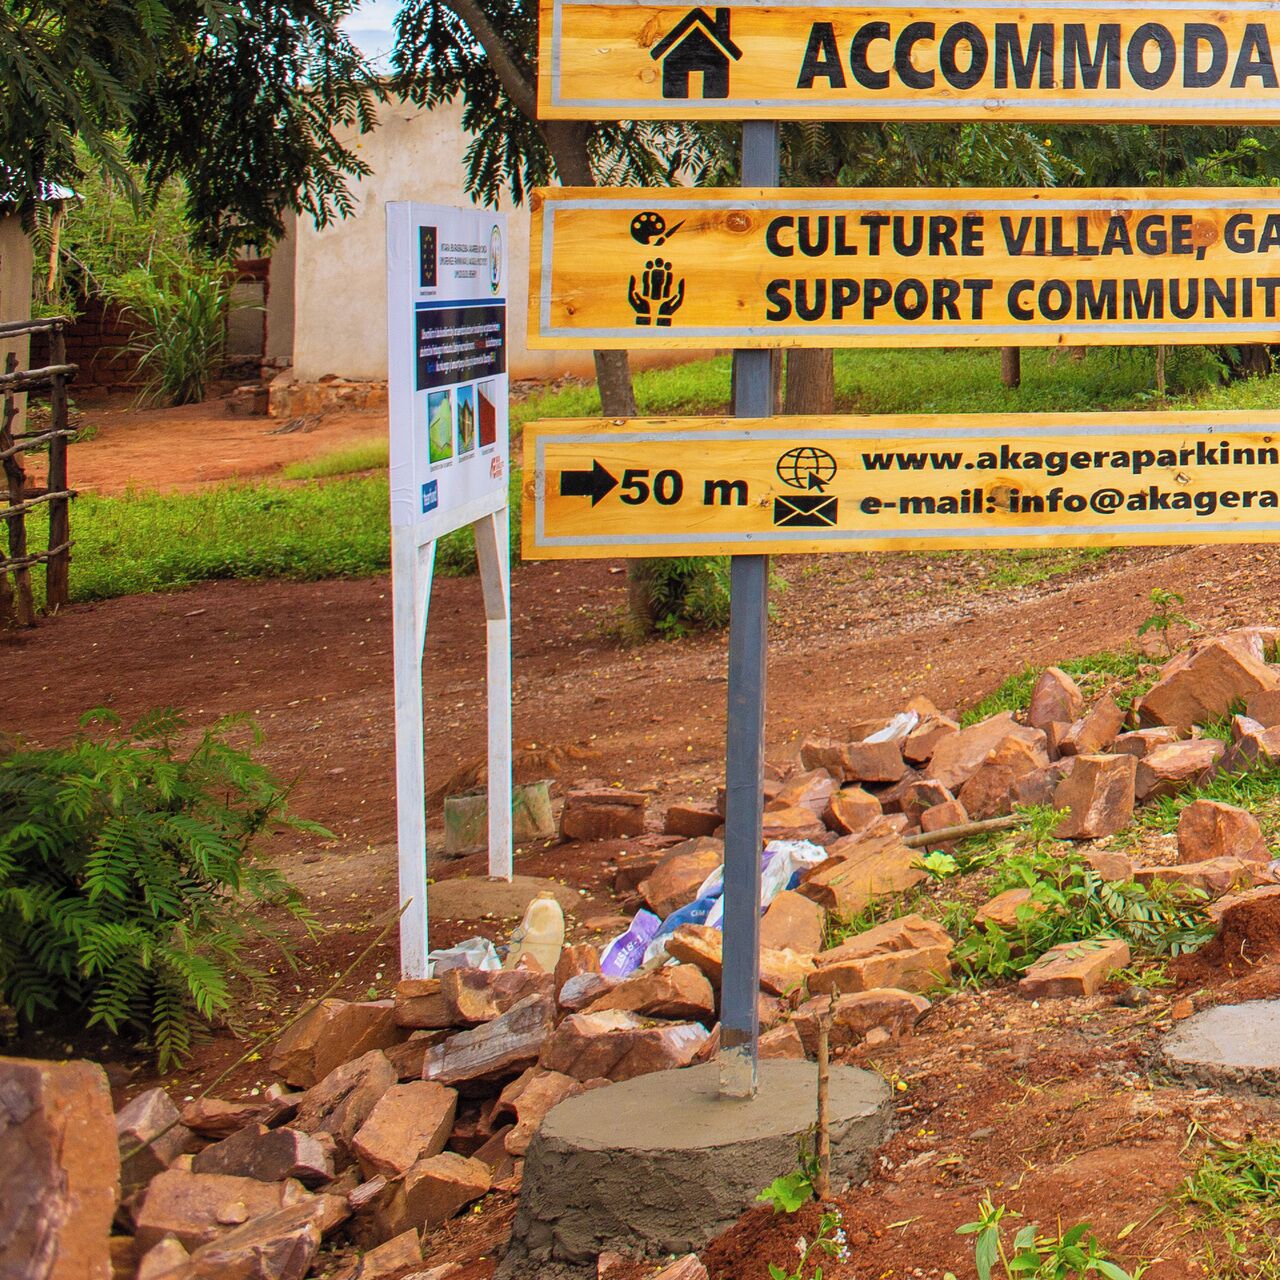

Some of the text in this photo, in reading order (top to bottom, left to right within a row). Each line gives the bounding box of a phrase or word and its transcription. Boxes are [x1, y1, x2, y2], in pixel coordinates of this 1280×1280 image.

[766, 216, 984, 257] CULTURE
[1000, 215, 1206, 260] VILLAGE,
[766, 279, 993, 322] SUPPORT
[620, 470, 748, 505] 50 m
[861, 489, 996, 514] e-mail:
